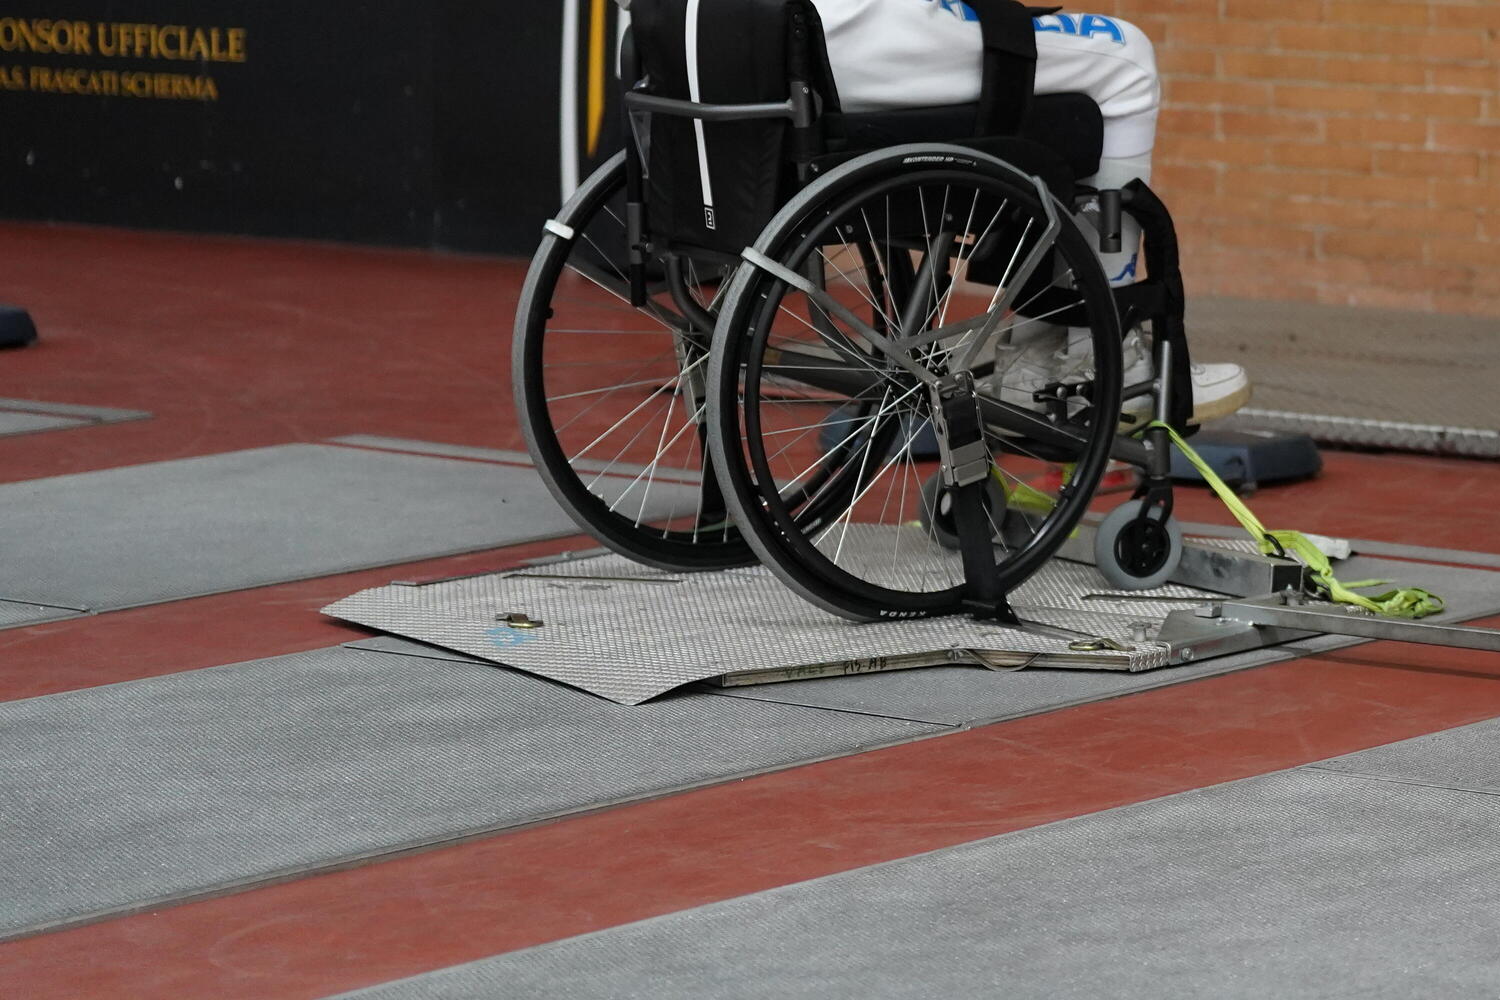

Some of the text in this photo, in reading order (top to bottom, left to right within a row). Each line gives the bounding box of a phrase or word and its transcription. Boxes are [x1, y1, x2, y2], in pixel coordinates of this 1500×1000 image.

[98, 22, 248, 63] UFFICIALE
[30, 66, 119, 96] FRASCATI
[121, 71, 219, 101] SCHERMA
